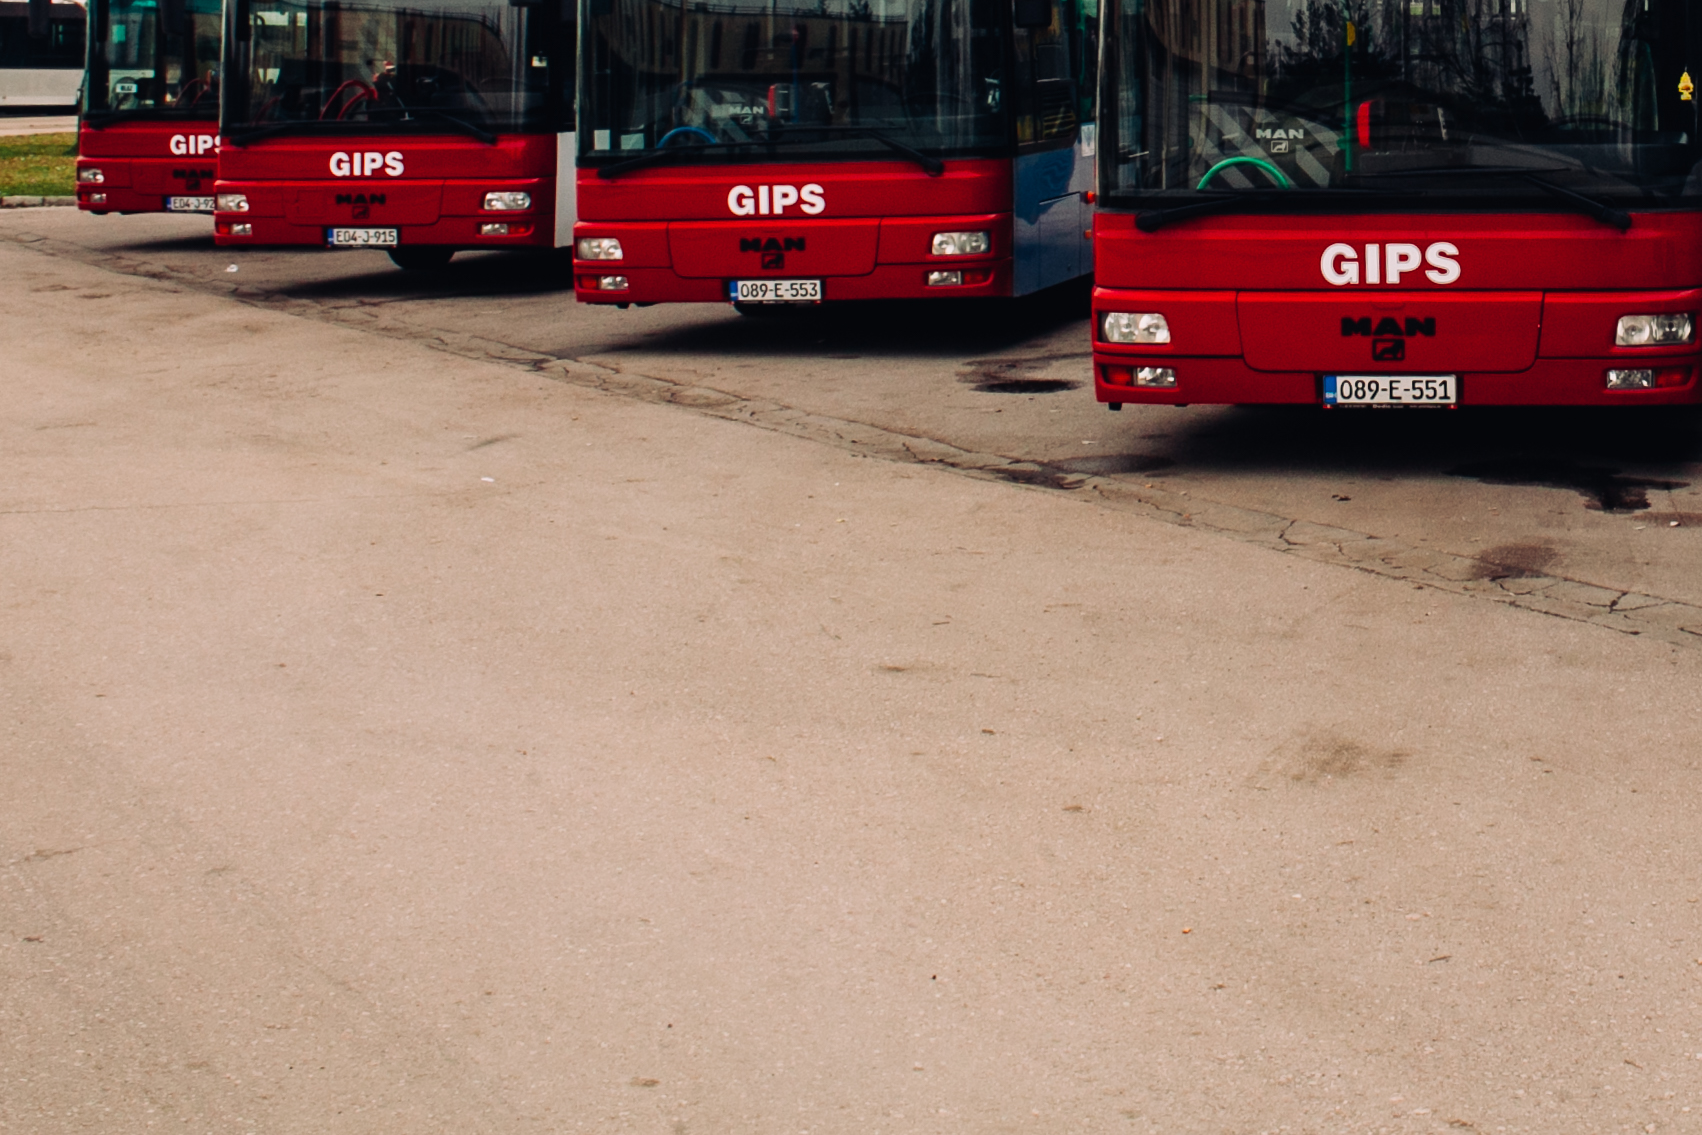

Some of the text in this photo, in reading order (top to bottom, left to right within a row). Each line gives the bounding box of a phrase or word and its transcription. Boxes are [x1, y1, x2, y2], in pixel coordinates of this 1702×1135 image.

[1256, 128, 1304, 139] MAN
[329, 151, 405, 177] GIPS
[336, 193, 386, 204] MAN
[727, 183, 826, 216] GIPS
[336, 230, 396, 243] E04-J-915
[740, 237, 805, 252] MAN
[1320, 241, 1461, 286] GIPS
[740, 282, 818, 298] 089-E-553
[1341, 317, 1436, 337] MAN
[1340, 379, 1451, 401] 089-E-551
